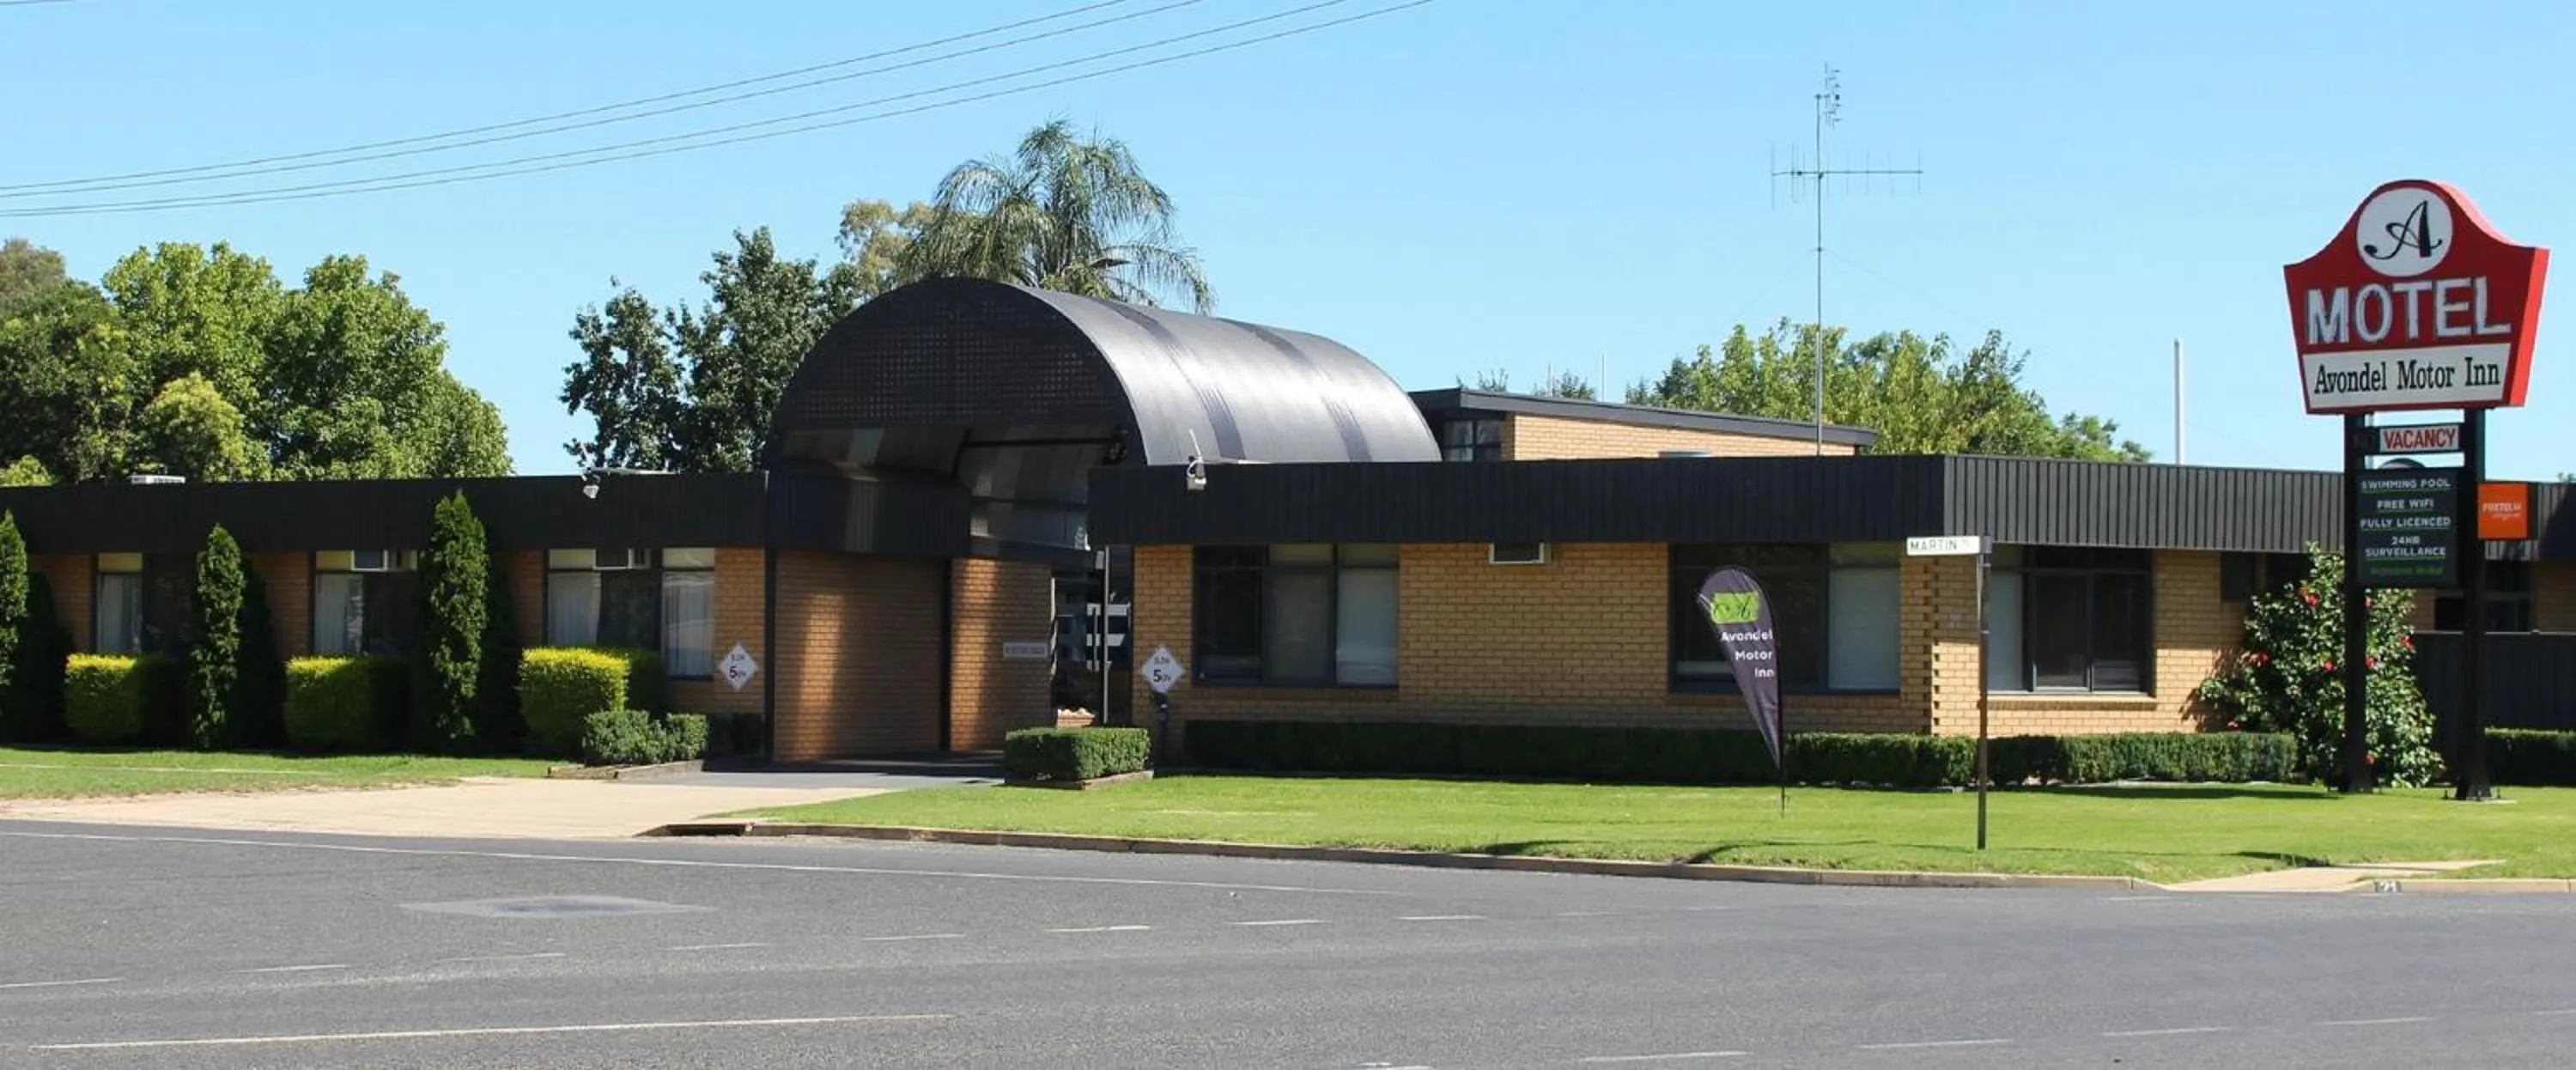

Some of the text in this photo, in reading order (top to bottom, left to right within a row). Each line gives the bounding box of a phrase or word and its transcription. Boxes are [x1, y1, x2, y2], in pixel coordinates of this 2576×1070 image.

[2363, 200, 2442, 259] A
[2306, 276, 2512, 344] MOTEL
[2313, 356, 2500, 394] Avondel Motor Inn
[2384, 429, 2456, 448] VACANCY
[2362, 478, 2451, 489] SWIMMING POOL
[2377, 498, 2434, 509] FREE WIFI
[2360, 516, 2451, 528] FULLY LICENCED
[1910, 539, 1958, 550] MARTIN
[2365, 547, 2446, 556] SURVEILLANCE
[1720, 629, 1773, 642] Avondel
[1735, 650, 1773, 660] Motor
[730, 666, 738, 678] 5
[1153, 669, 1163, 683] 5
[1754, 667, 1776, 678] Inn
